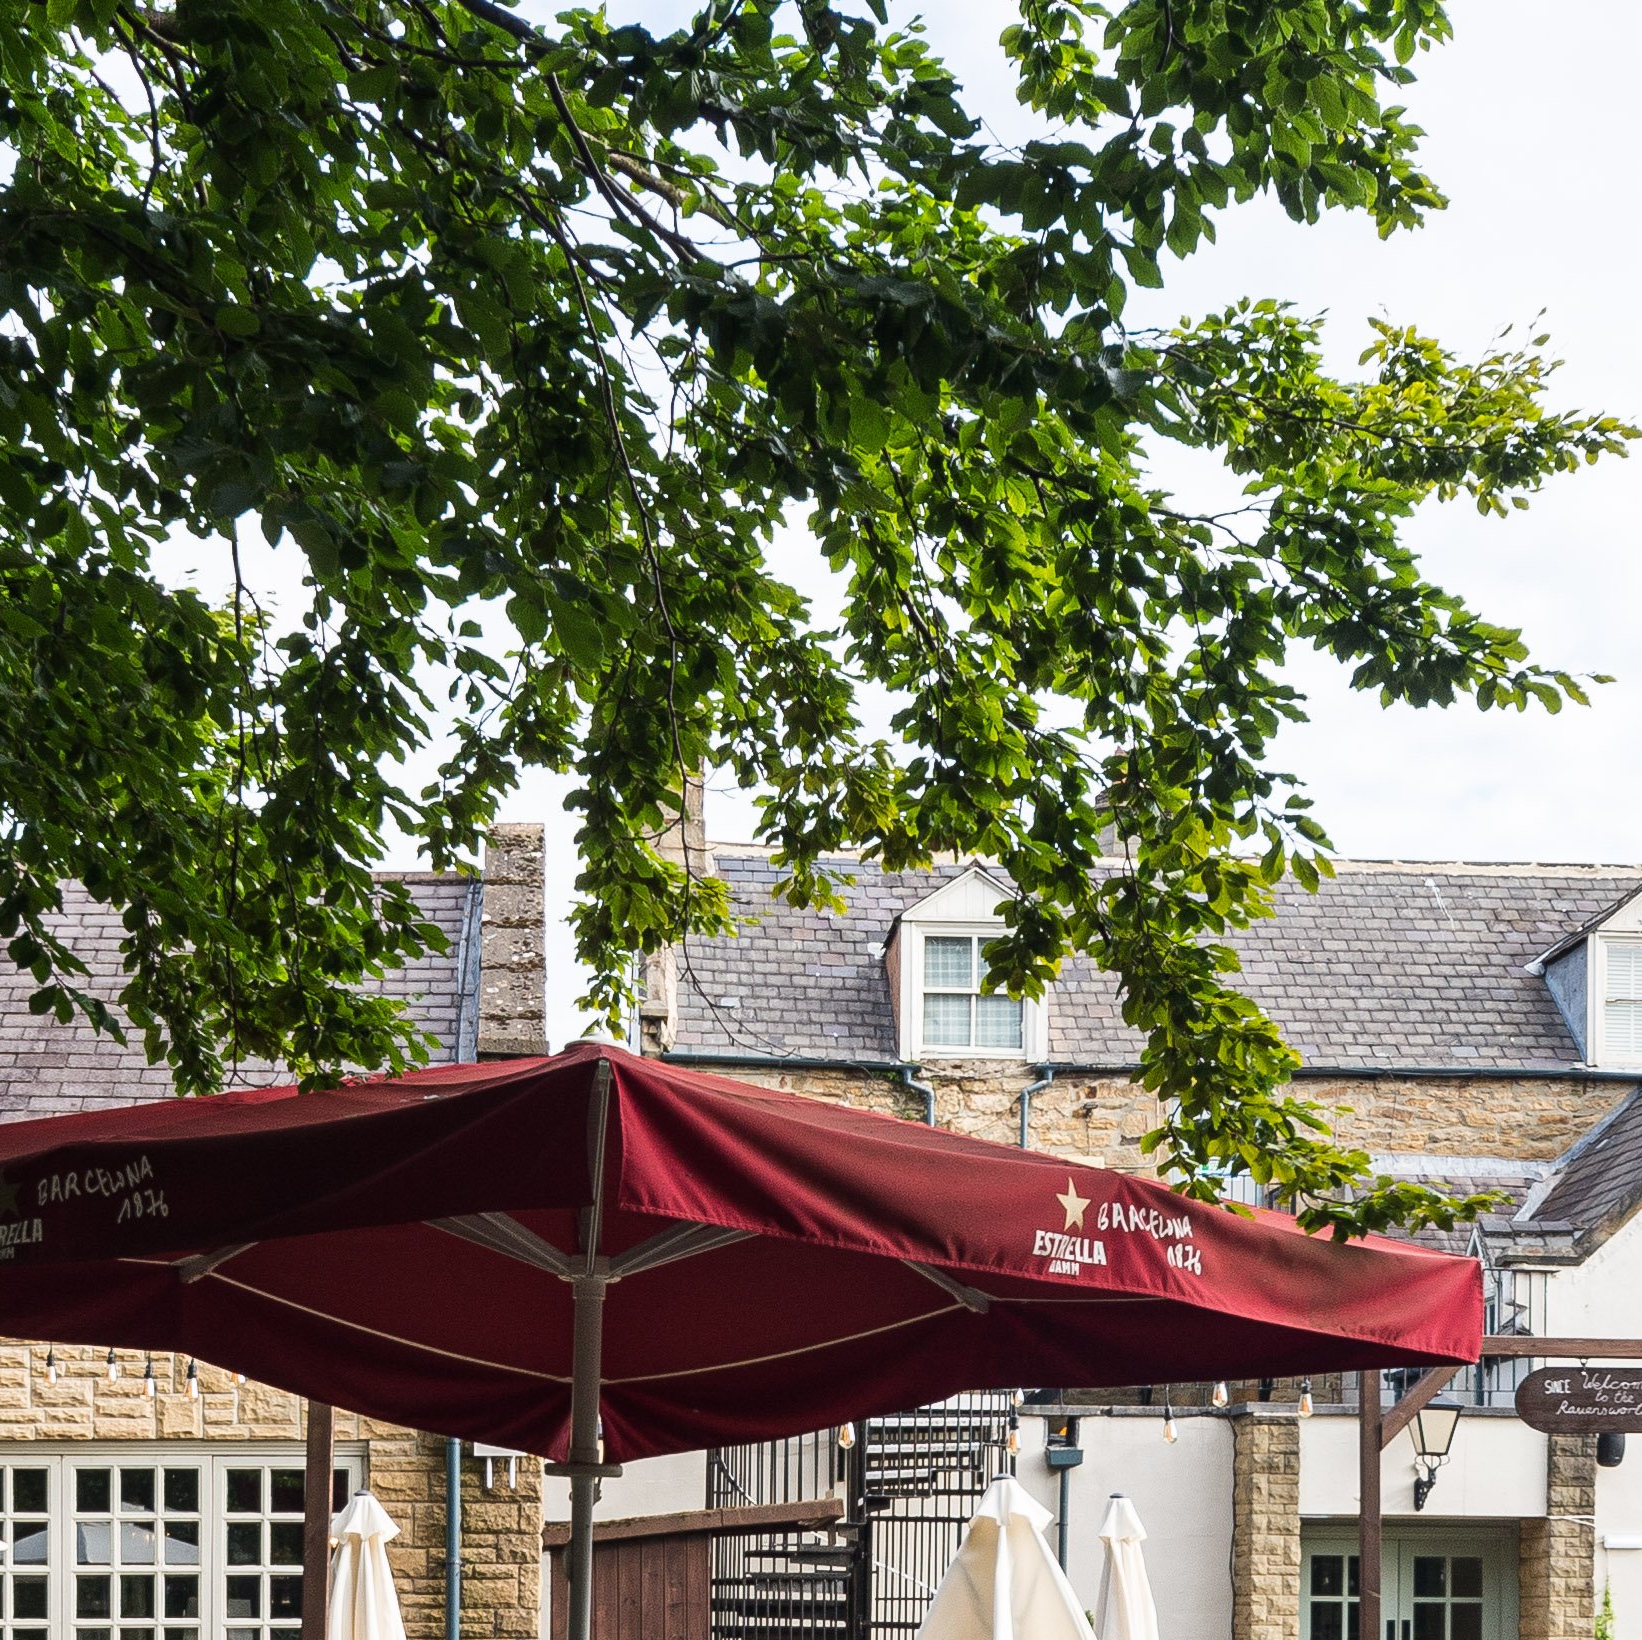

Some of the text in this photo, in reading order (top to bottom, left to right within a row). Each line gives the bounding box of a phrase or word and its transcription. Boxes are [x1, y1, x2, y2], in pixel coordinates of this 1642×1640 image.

[37, 1154, 154, 1207] BARCELONA
[116, 1189, 170, 1225] 1876
[1097, 1202, 1194, 1240] BARCELONA
[1032, 1229, 1108, 1265] ESTRELLA
[1166, 1243, 1202, 1276] 1876
[1048, 1258, 1081, 1276] DAMM
[1544, 1379, 1572, 1395] SINCE
[1594, 1389, 1635, 1404] to the
